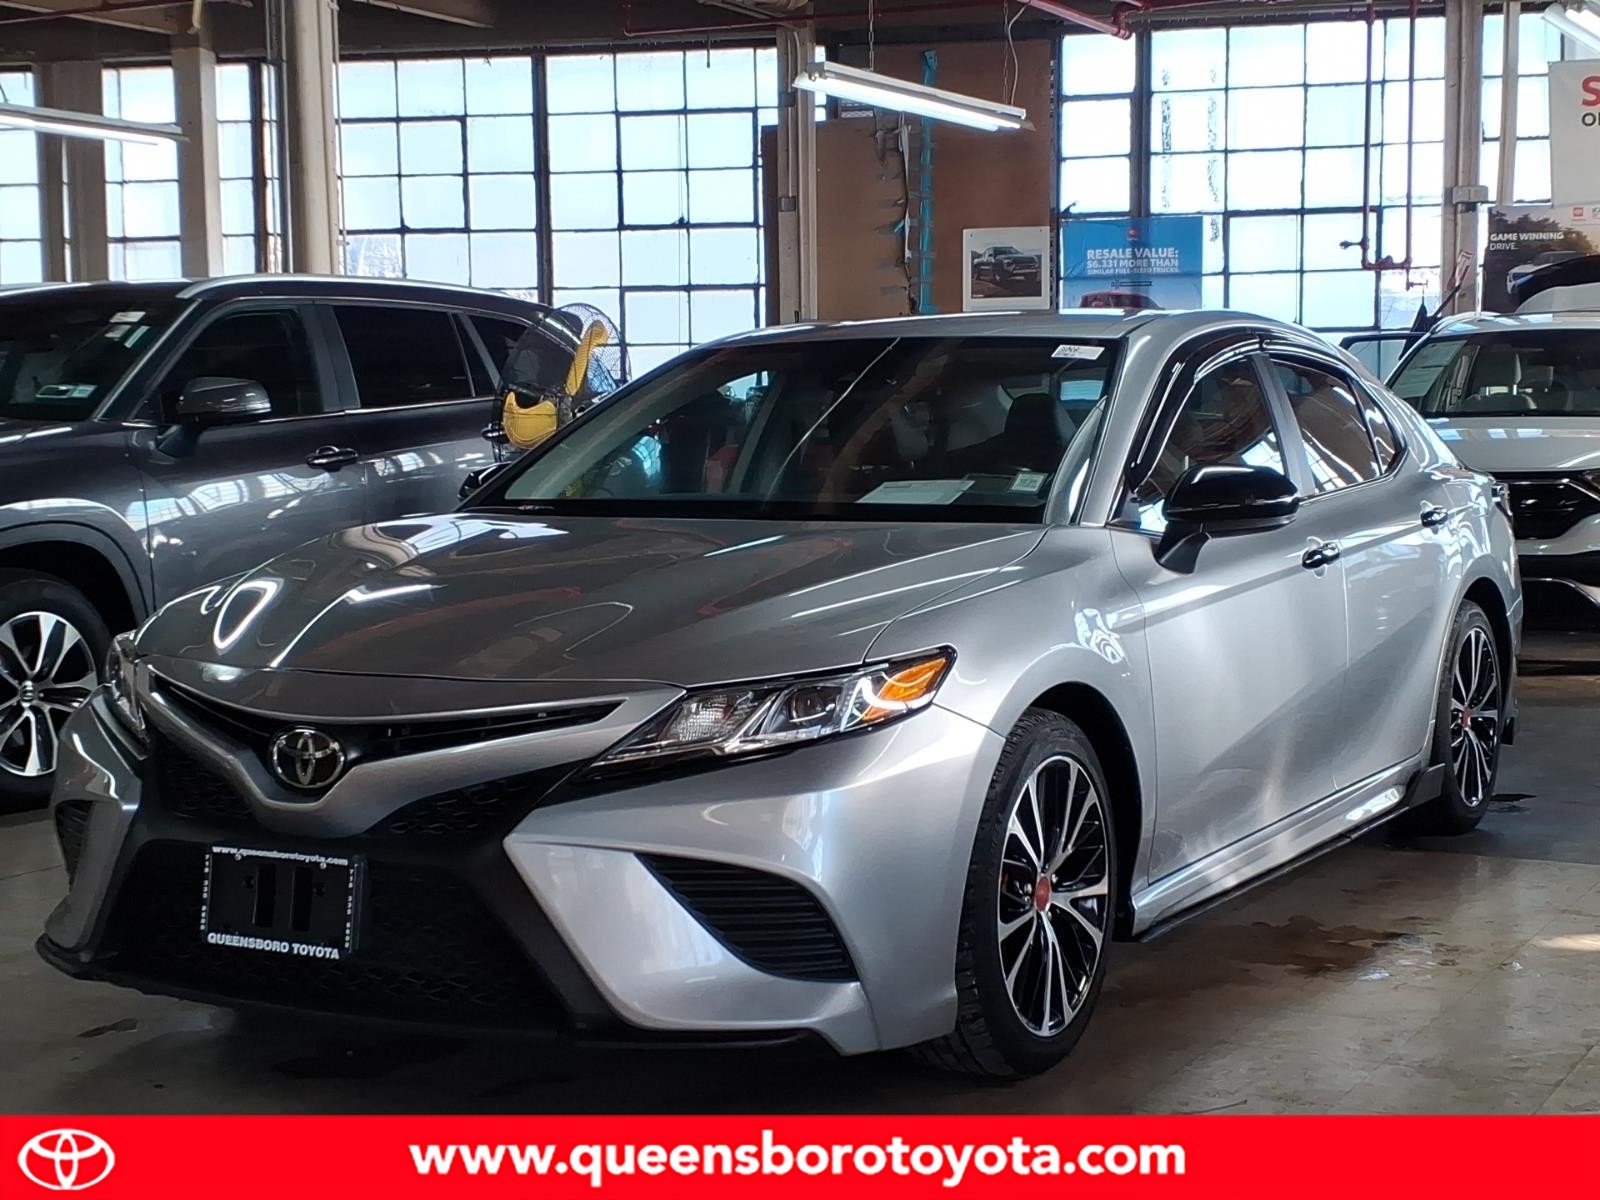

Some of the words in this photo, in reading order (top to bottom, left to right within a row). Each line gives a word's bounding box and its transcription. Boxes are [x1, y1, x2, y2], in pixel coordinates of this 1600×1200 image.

[1490, 233, 1518, 241] GAME
[1519, 231, 1565, 240] WINNING
[1489, 242, 1519, 251] DRIVE.
[1087, 248, 1132, 259] RESALE
[1134, 247, 1179, 258] VALUE:
[1119, 259, 1148, 267] MORE
[1150, 258, 1179, 267] THAN
[211, 846, 349, 866] www.queensborotoyota.com
[207, 932, 290, 953] QUEENSBORO
[291, 943, 340, 960] TOYOTA
